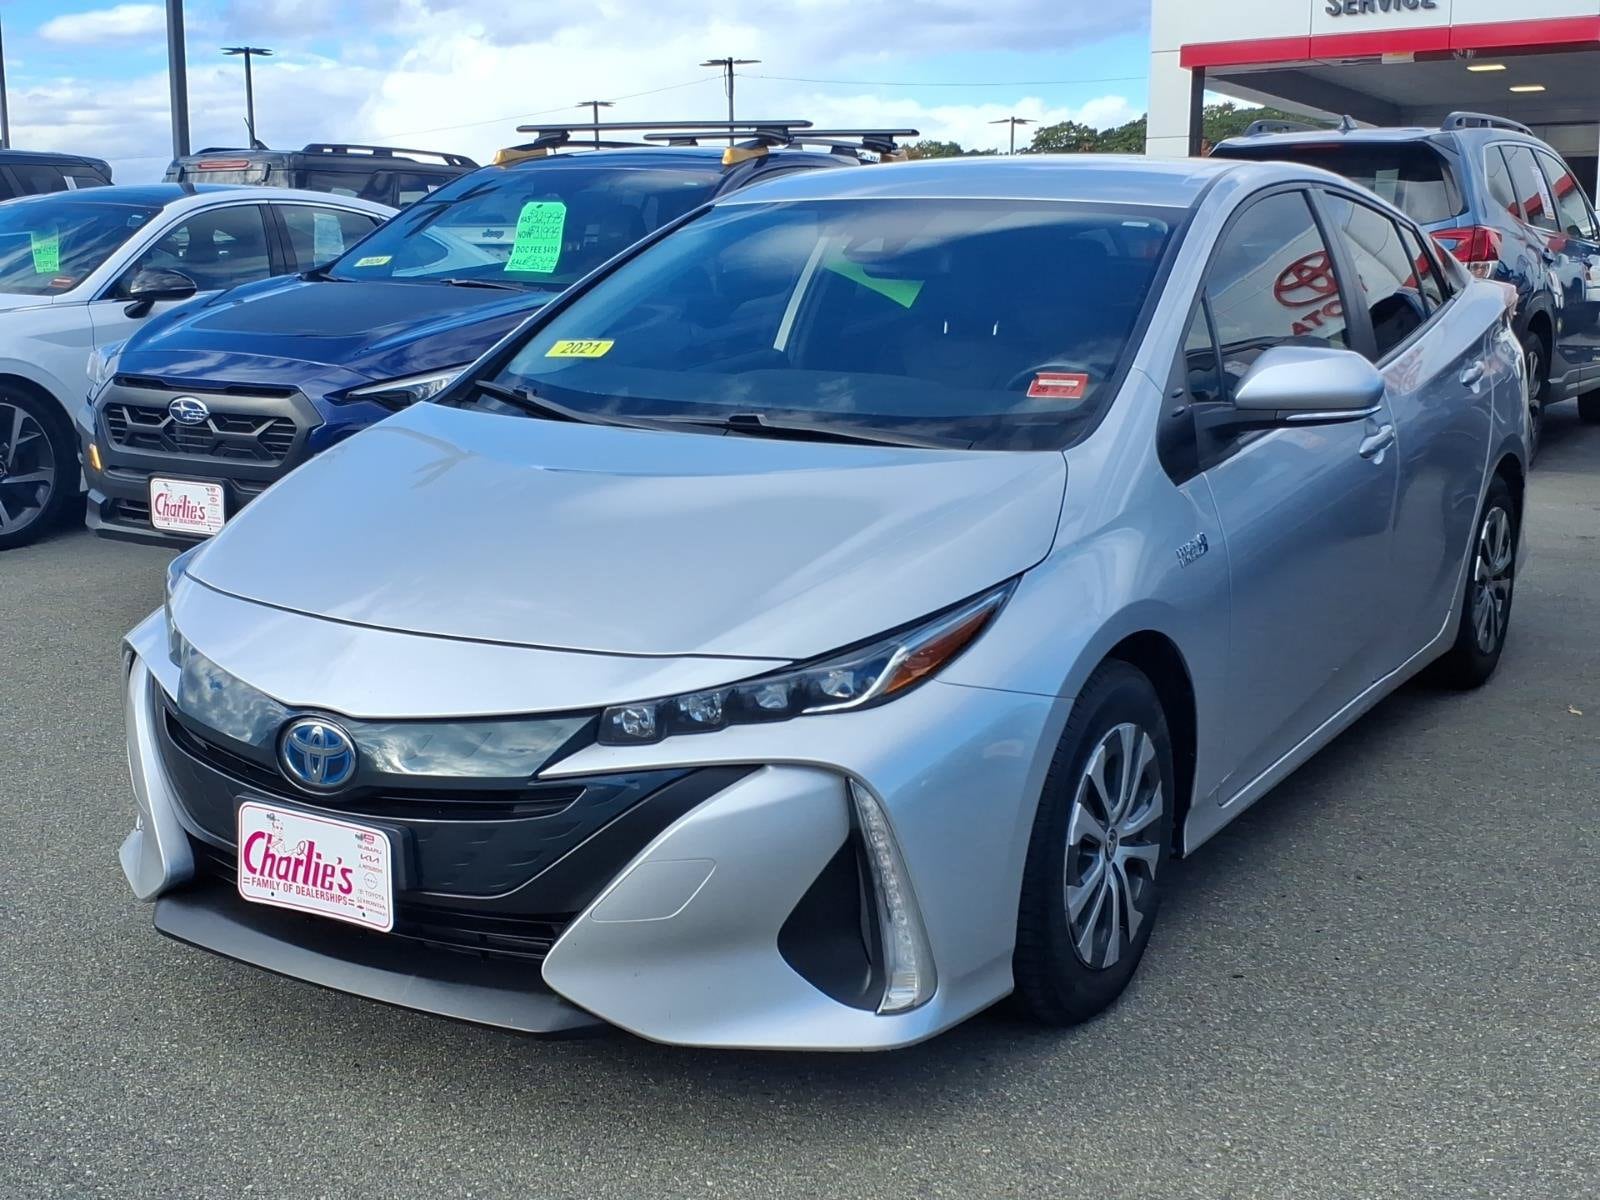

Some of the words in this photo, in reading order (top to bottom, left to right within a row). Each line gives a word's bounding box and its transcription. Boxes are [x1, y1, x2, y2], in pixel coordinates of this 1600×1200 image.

[482, 229, 504, 239] Jeep
[517, 231, 532, 239] NOW
[516, 245, 529, 253] DOC
[530, 245, 542, 254] FEE
[543, 245, 558, 254] $499
[511, 258, 527, 266] SALE
[560, 342, 602, 354] 2021
[155, 492, 206, 520] Charlie's
[243, 831, 353, 895] Charlie's
[251, 876, 280, 891] FAMILY
[283, 882, 294, 894] OF
[295, 884, 348, 907] DEALERSHIPS
[365, 890, 385, 901] TOYOTA
